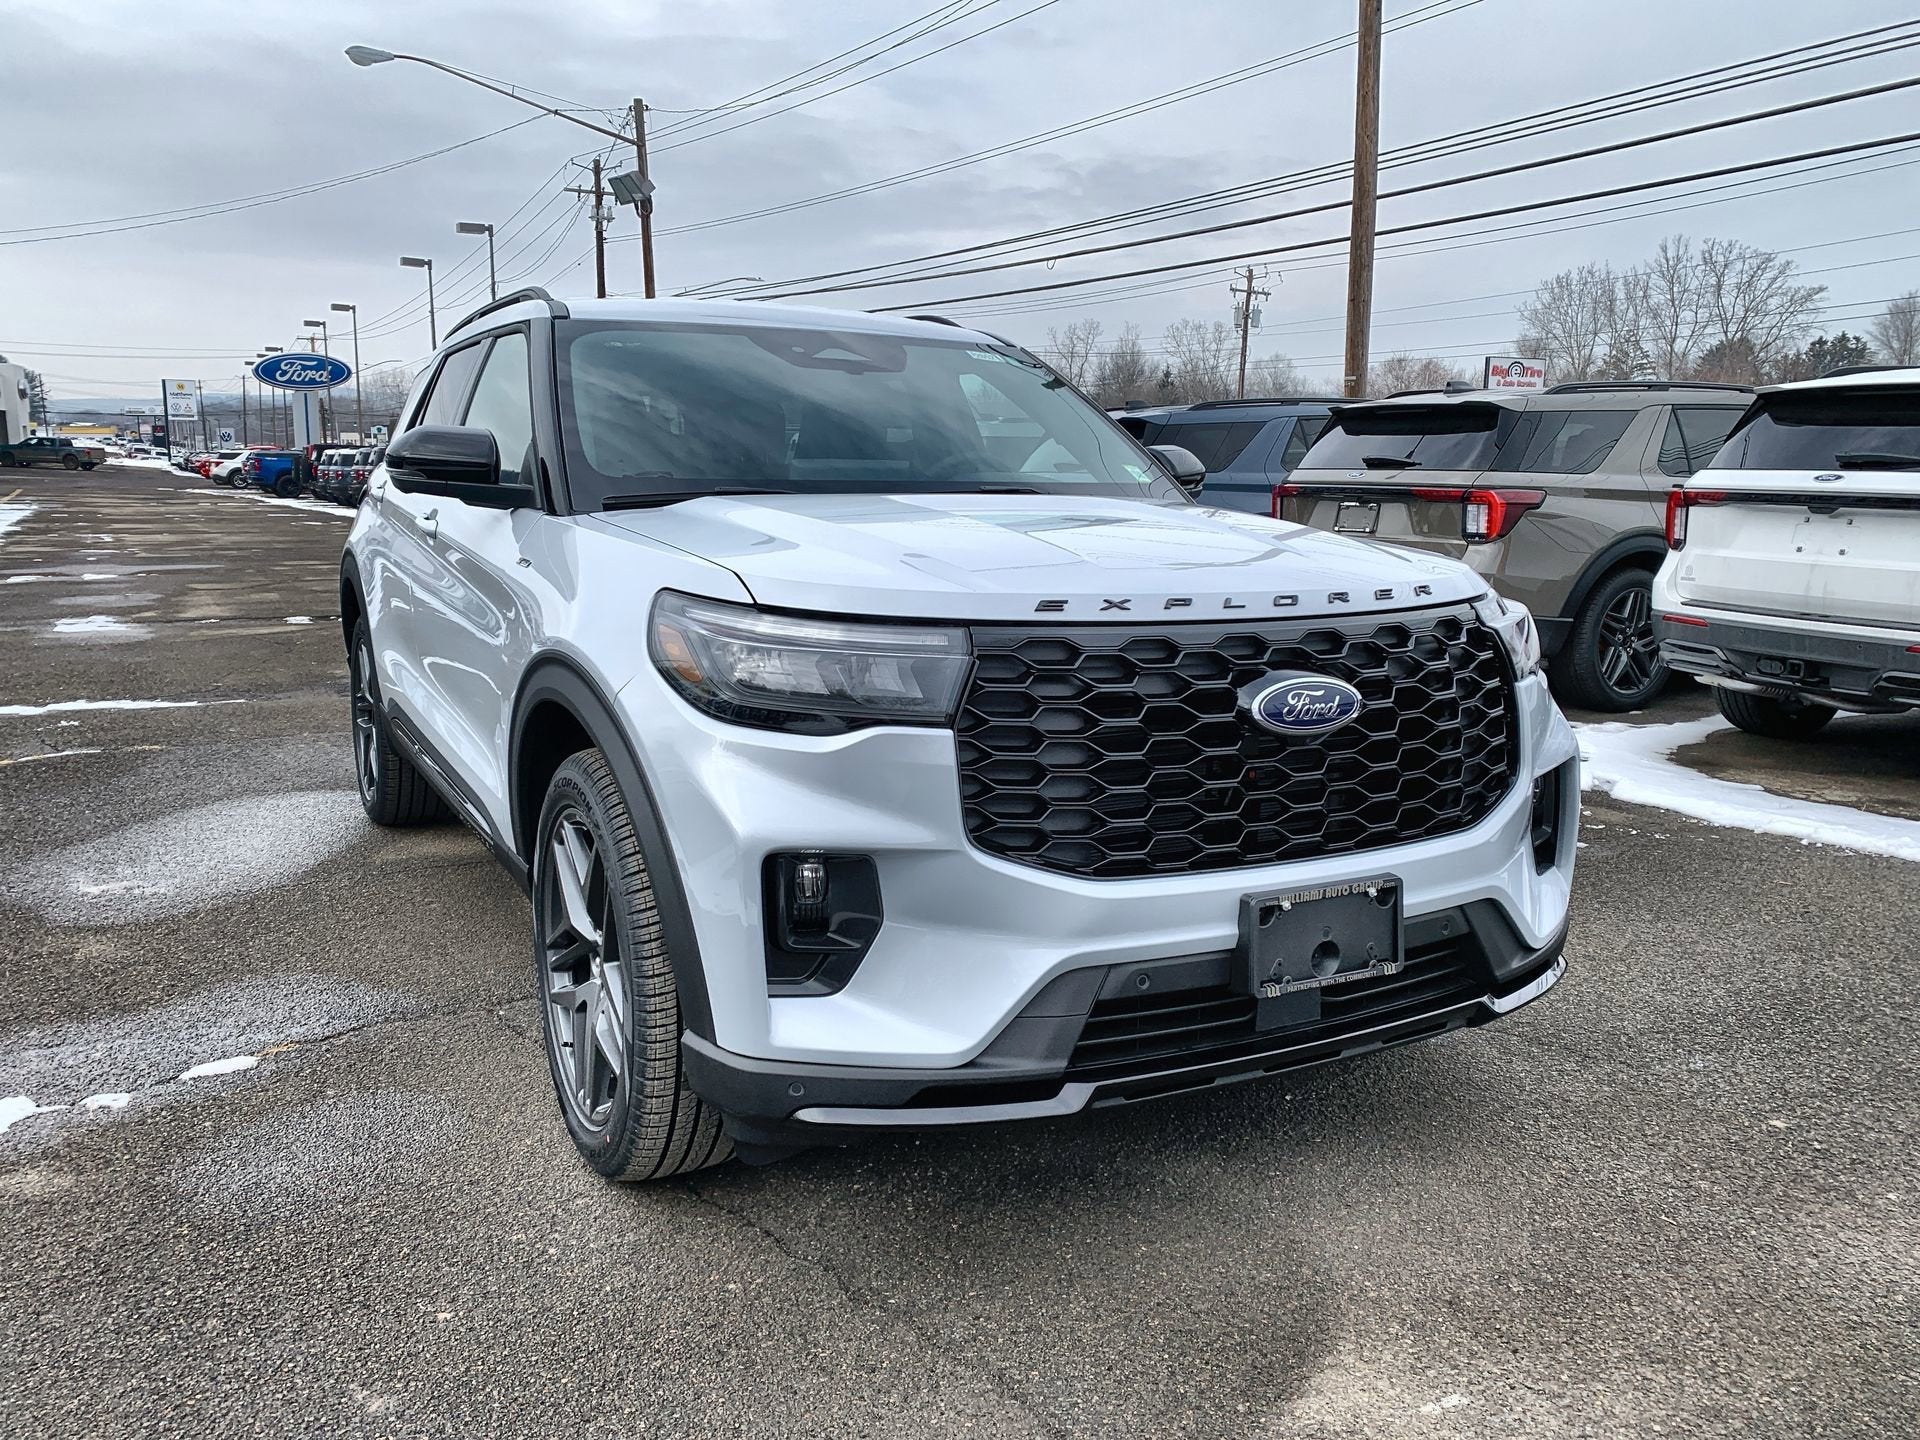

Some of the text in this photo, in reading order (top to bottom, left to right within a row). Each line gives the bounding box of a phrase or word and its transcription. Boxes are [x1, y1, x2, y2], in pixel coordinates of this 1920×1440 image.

[276, 360, 332, 381] Ford
[1491, 365, 1543, 379] Big Tire
[1034, 584, 1433, 612] EXPLORER
[1283, 690, 1341, 720] Ford
[553, 777, 593, 813] SCORPION
[1279, 888, 1323, 904] WILLIAMS
[1325, 886, 1349, 898] AUTO
[1287, 971, 1377, 992] PARTNERING WITH THE COMMUNITY
